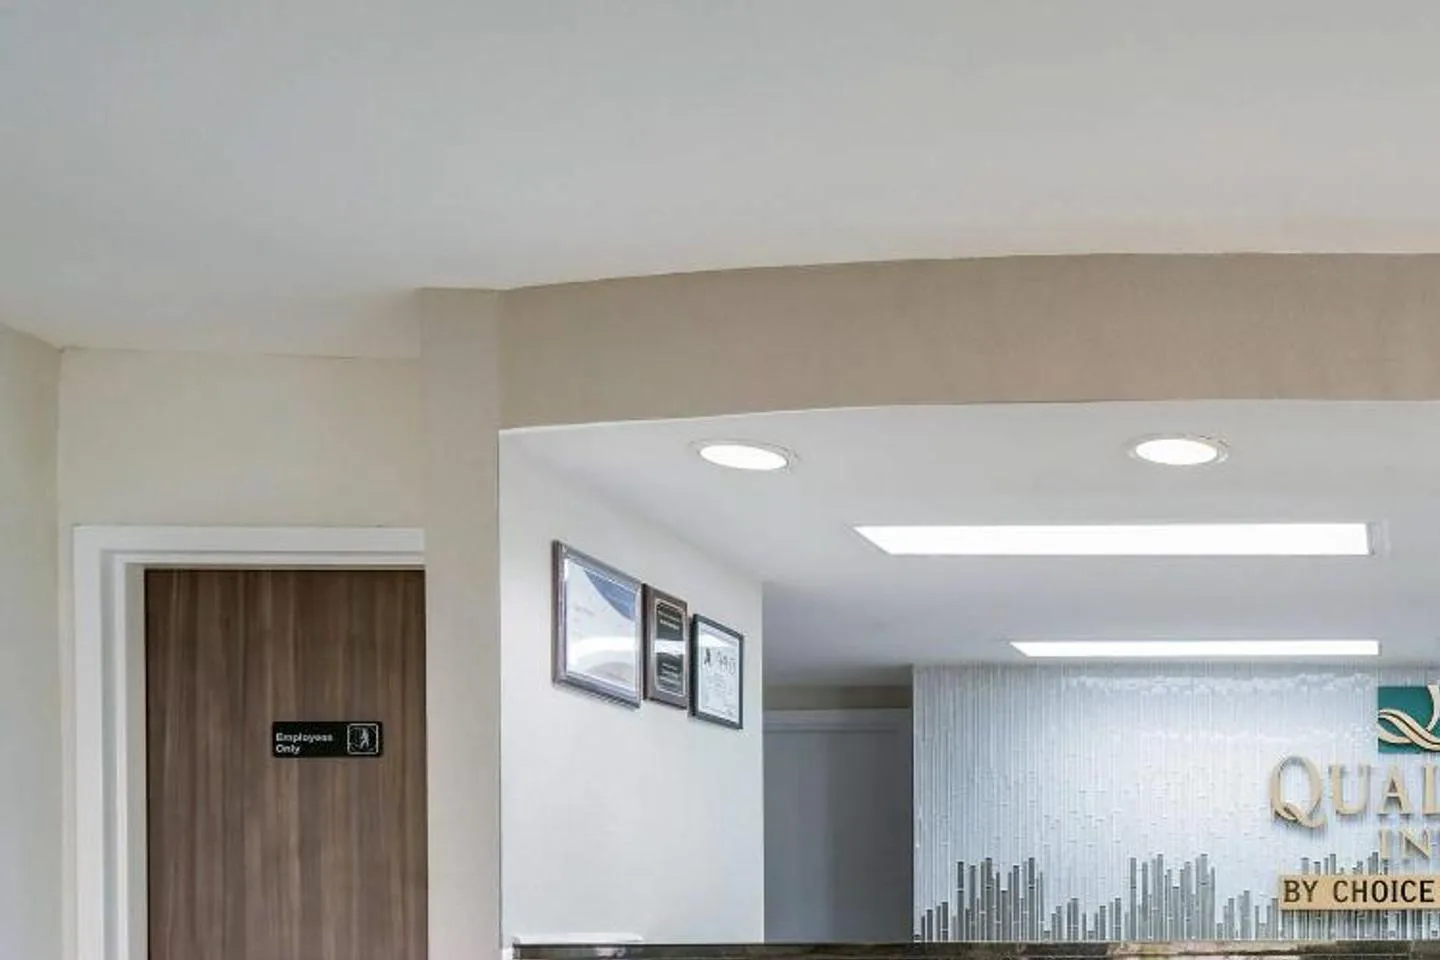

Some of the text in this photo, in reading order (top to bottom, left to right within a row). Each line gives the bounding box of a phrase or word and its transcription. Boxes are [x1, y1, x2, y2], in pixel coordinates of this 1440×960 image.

[276, 732, 333, 743] Employees
[276, 744, 300, 755] Only
[1284, 879, 1319, 903] BY
[1332, 879, 1435, 903] CHOICE
